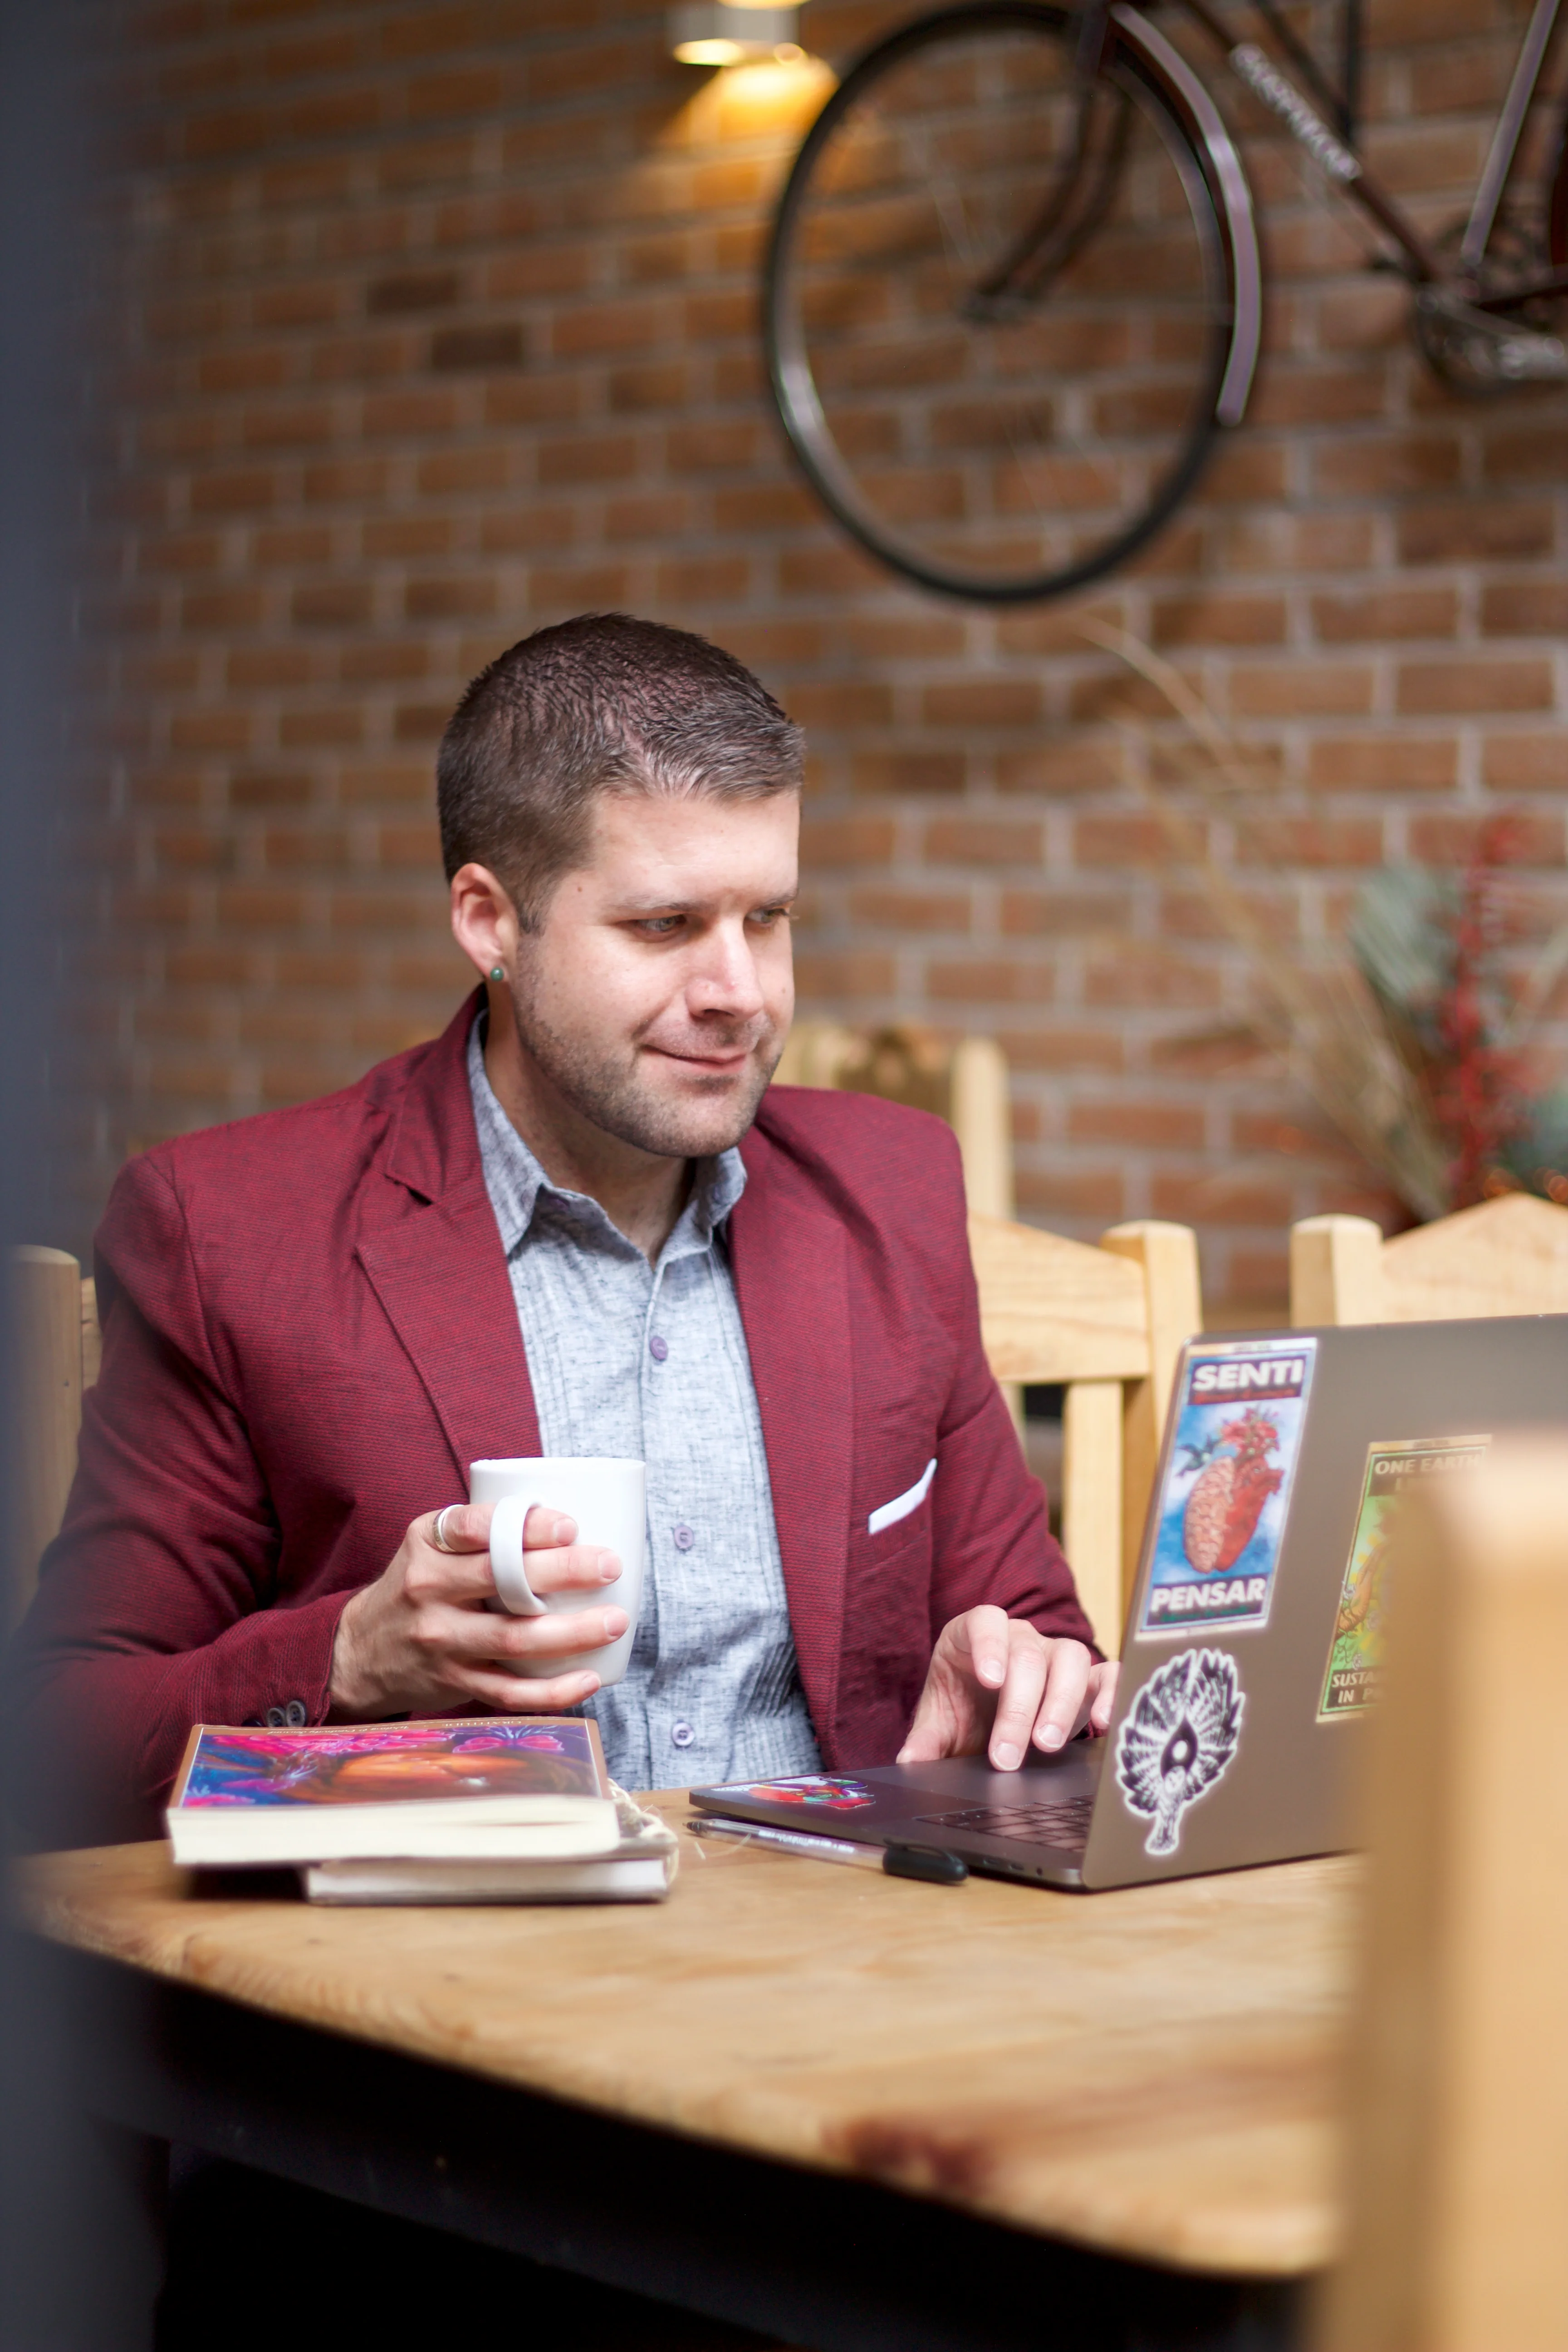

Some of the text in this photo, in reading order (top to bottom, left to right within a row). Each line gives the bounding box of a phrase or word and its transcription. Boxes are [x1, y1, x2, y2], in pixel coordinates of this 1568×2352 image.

[1192, 1359, 1303, 1392] SENTI
[1375, 1453, 1482, 1475] ONE EARTH
[1151, 1577, 1266, 1612] PENSAR
[1331, 1671, 1377, 1687] SUSTA
[1338, 1689, 1355, 1703] IN
